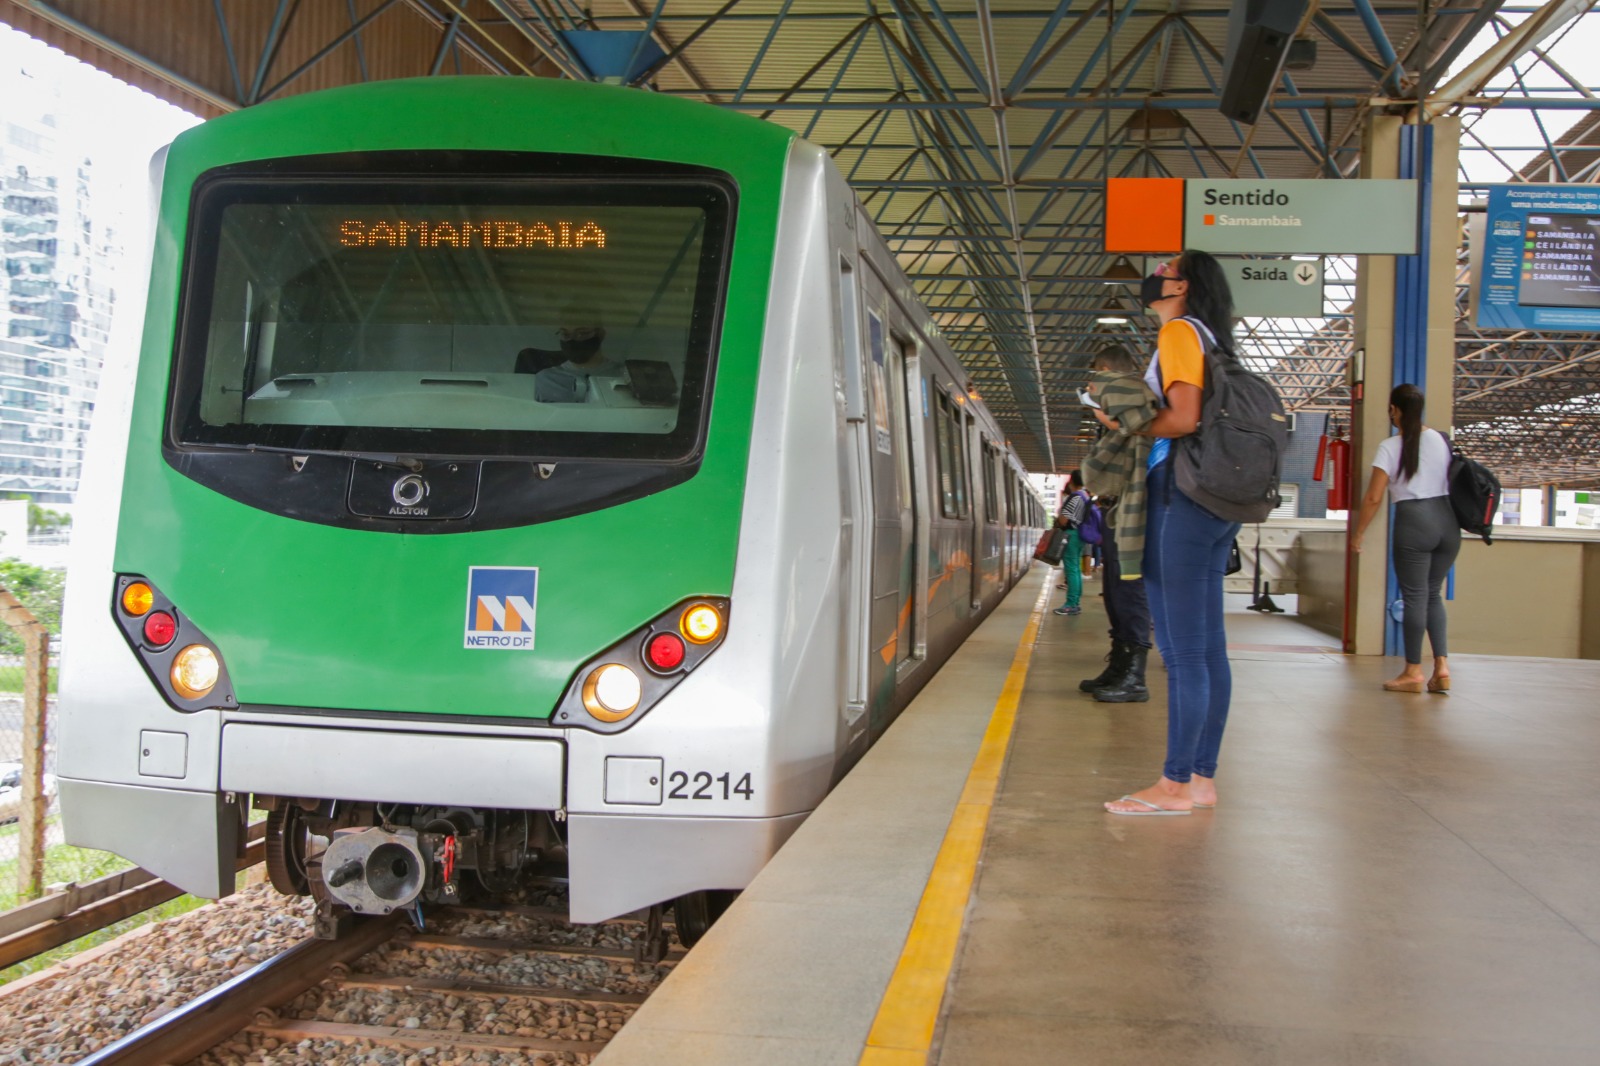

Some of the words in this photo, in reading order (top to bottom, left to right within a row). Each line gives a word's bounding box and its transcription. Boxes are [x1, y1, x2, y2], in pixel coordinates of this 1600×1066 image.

[1203, 188, 1290, 206] Sentido
[1506, 190, 1558, 199] Acompanhe
[1218, 214, 1302, 227] Samambaia
[340, 221, 606, 248] SAMAMBAIA
[1536, 231, 1596, 240] SAMAMBAIA
[1534, 252, 1593, 261] SAMAMBAIA
[1241, 267, 1288, 281] Saída
[1532, 273, 1591, 282] SAMAMBAIA
[388, 506, 429, 516] ALSTOM
[513, 636, 532, 647] DF
[668, 770, 755, 801] 2214
